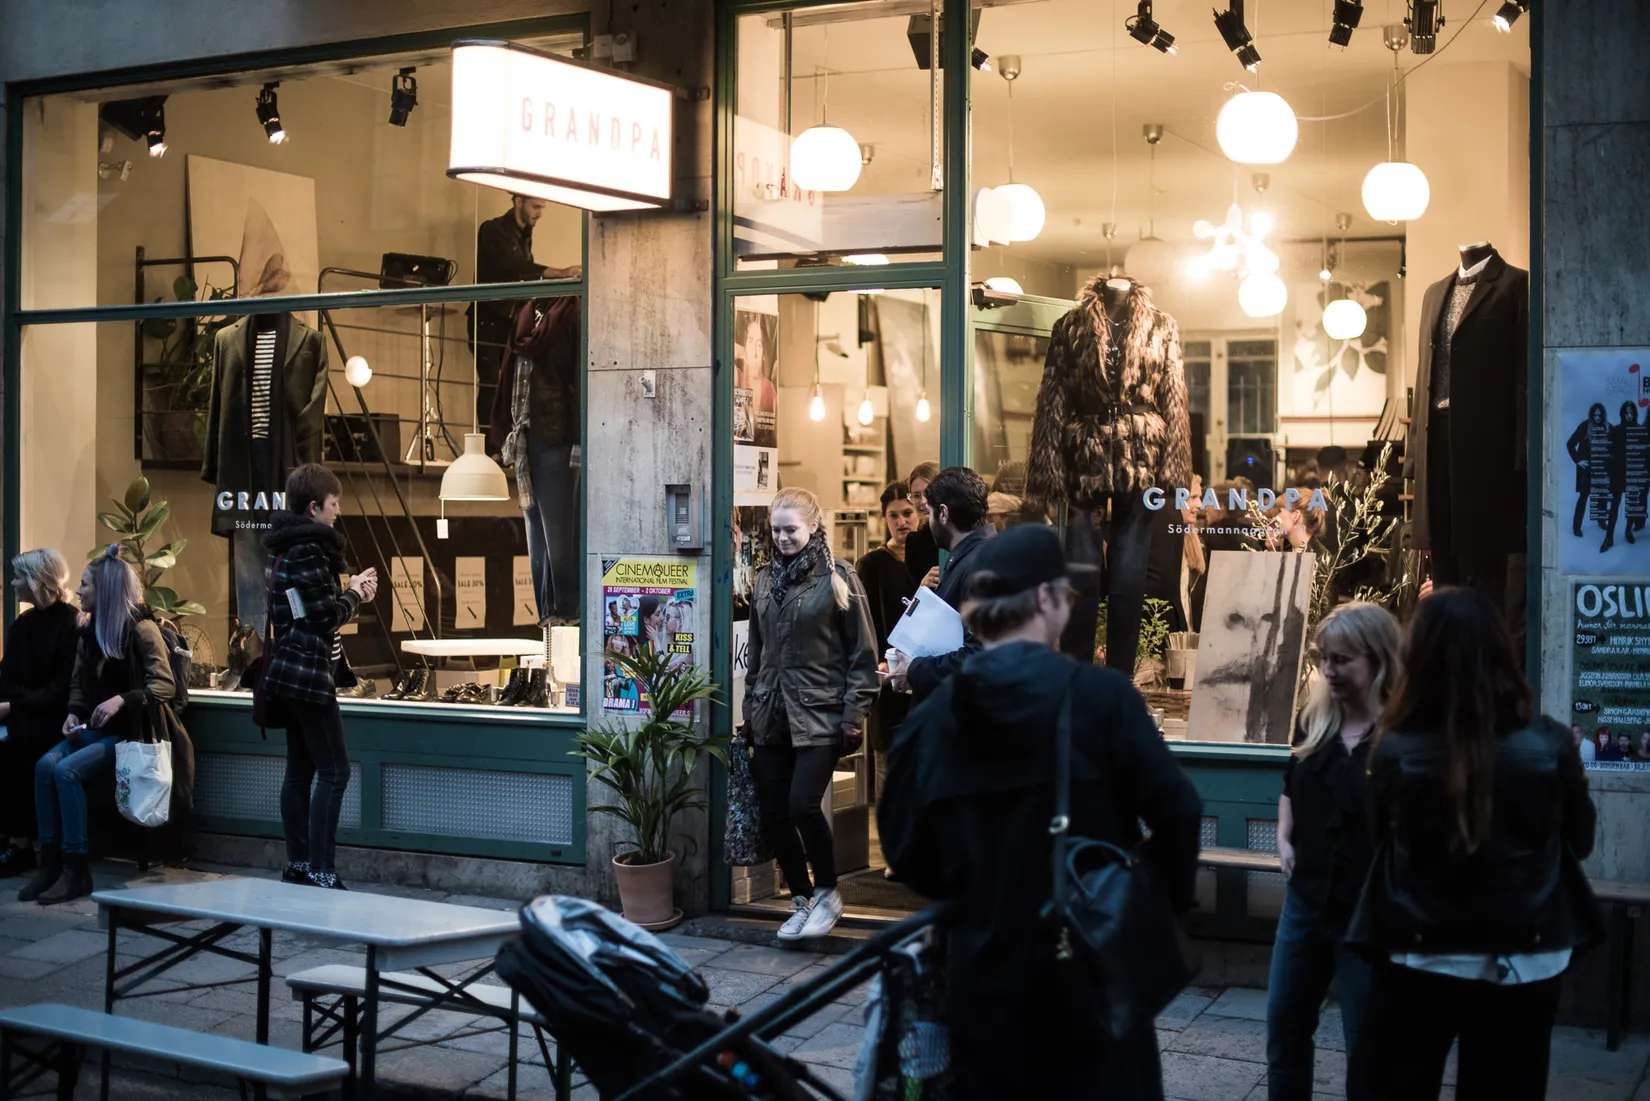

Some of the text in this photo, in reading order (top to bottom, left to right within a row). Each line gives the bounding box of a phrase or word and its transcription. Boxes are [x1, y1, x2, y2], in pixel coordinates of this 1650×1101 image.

[521, 97, 660, 162] GRANDPA
[217, 491, 286, 511] GRAN
[1143, 487, 1328, 512] GRANDPA
[235, 520, 272, 529] Söderma
[675, 633, 693, 642] KISS
[675, 645, 690, 653] TELL
